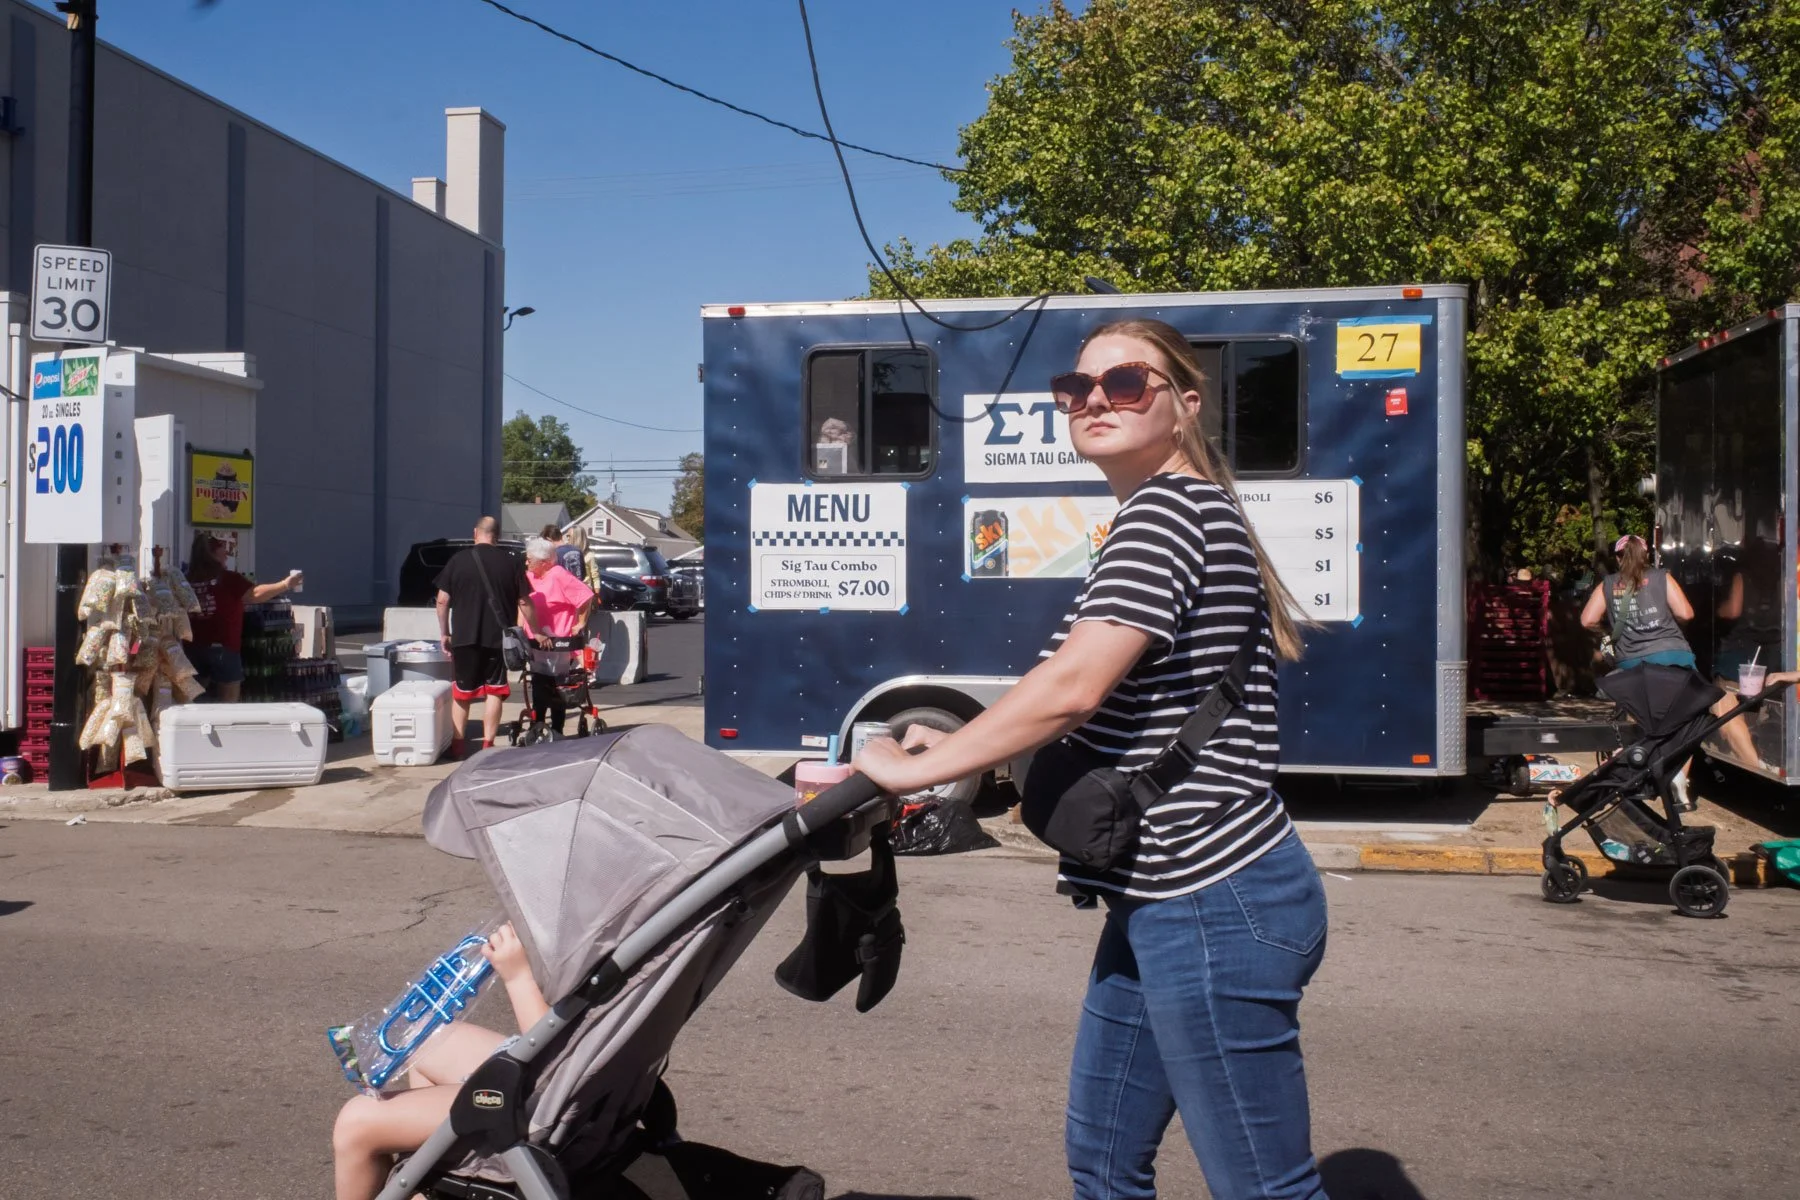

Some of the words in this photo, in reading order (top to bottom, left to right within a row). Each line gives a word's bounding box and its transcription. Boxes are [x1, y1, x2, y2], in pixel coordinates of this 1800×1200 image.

[42, 256, 104, 273] SPEED
[48, 276, 96, 292] LIMIT
[40, 296, 100, 332] 30
[1357, 333, 1399, 362] 27
[43, 373, 60, 385] pepsi
[56, 402, 81, 418] SINGLES
[984, 453, 1026, 466] SIGMA
[1030, 452, 1053, 465] TAU
[1058, 451, 1090, 464] GAM
[1315, 491, 1333, 504] $6
[787, 494, 871, 522] MENU
[1315, 527, 1334, 540] $5
[782, 560, 801, 573] Sig
[805, 560, 828, 571] Tau
[831, 560, 877, 571] Combo
[1315, 559, 1331, 572] $1
[764, 591, 791, 599] CHIPS
[794, 591, 801, 599] &
[803, 591, 832, 599] DRINK
[838, 580, 890, 596] $7.00
[1314, 593, 1331, 606] $1
